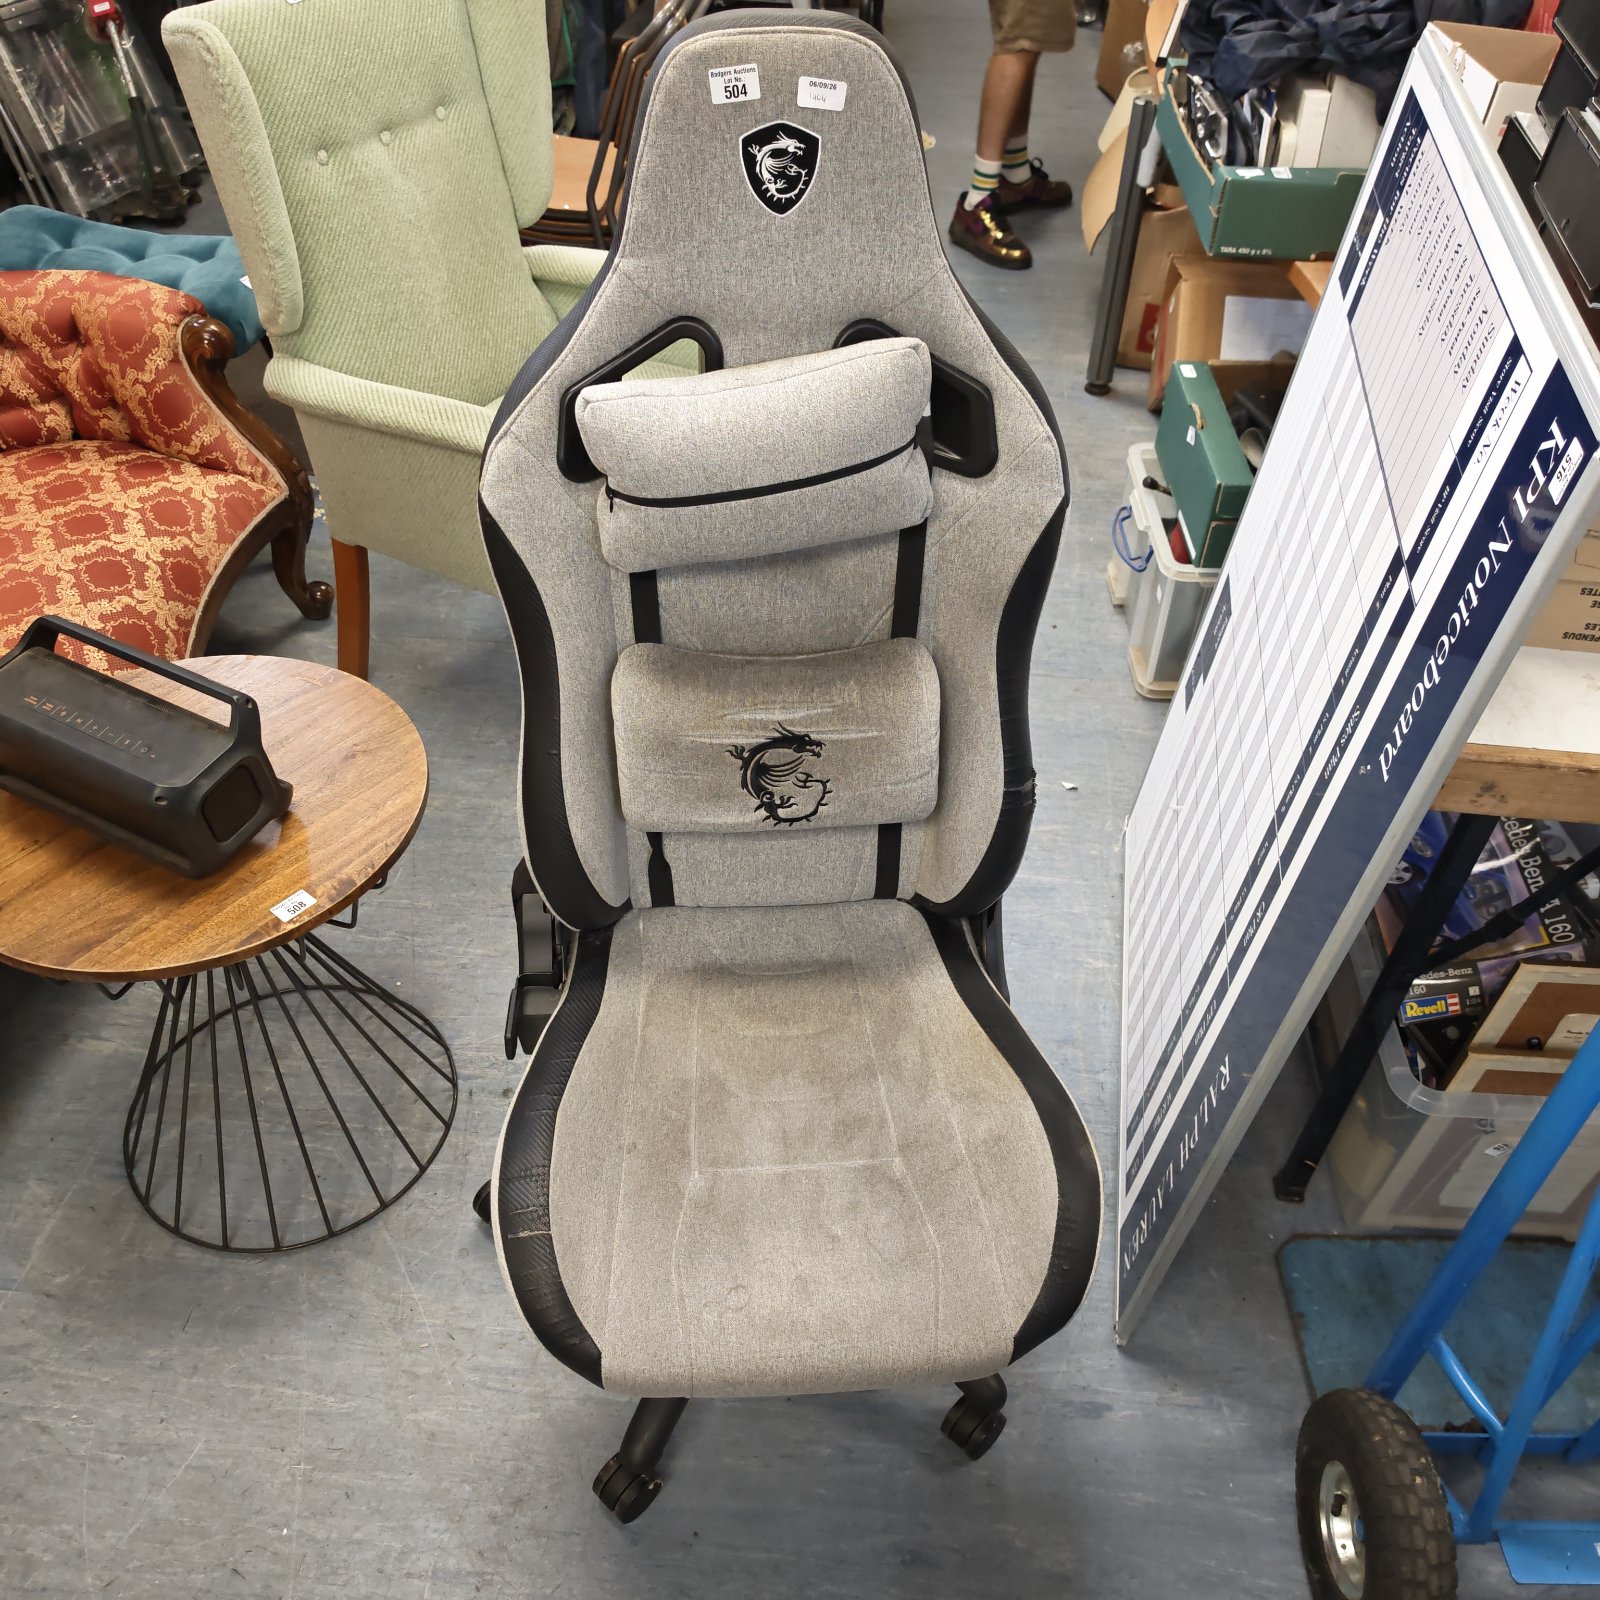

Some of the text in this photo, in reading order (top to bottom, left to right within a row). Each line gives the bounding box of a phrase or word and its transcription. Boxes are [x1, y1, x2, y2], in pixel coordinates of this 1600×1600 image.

[710, 67, 756, 78] Badgers Auctions
[724, 83, 748, 99] 504
[809, 81, 837, 90] 06/09/26
[1390, 119, 1410, 168] Action
[1394, 126, 1416, 178] Target
[1360, 135, 1420, 287] Focus for the Week
[1416, 184, 1440, 238] Friday
[1417, 198, 1444, 262] Sub-Total
[1415, 212, 1450, 291] Thursday
[1426, 226, 1455, 292] Sub-Total
[1417, 240, 1462, 339] Wednesday
[1437, 255, 1467, 323] Sub-Total
[1439, 271, 1473, 345] Tuesday
[1448, 287, 1480, 357] Sub-Total
[1452, 305, 1488, 377] Monday
[1460, 320, 1495, 391] Sunday
[1466, 357, 1512, 448] Store Visit Score
[1475, 376, 1521, 467] Week No.
[1556, 453, 1571, 481] 516
[1416, 525, 1429, 554] Score
[1430, 501, 1442, 525] Visit
[1378, 414, 1566, 785] KPI Noticeboard
[1380, 574, 1392, 599] Plan
[1324, 703, 1360, 781] Sales Plan
[287, 901, 307, 915] 508
[1544, 914, 1576, 943] 160
[1415, 967, 1473, 980] edes-Benz
[1405, 999, 1447, 1018] Revell
[1123, 1051, 1229, 1275] RALPH LAUREN
